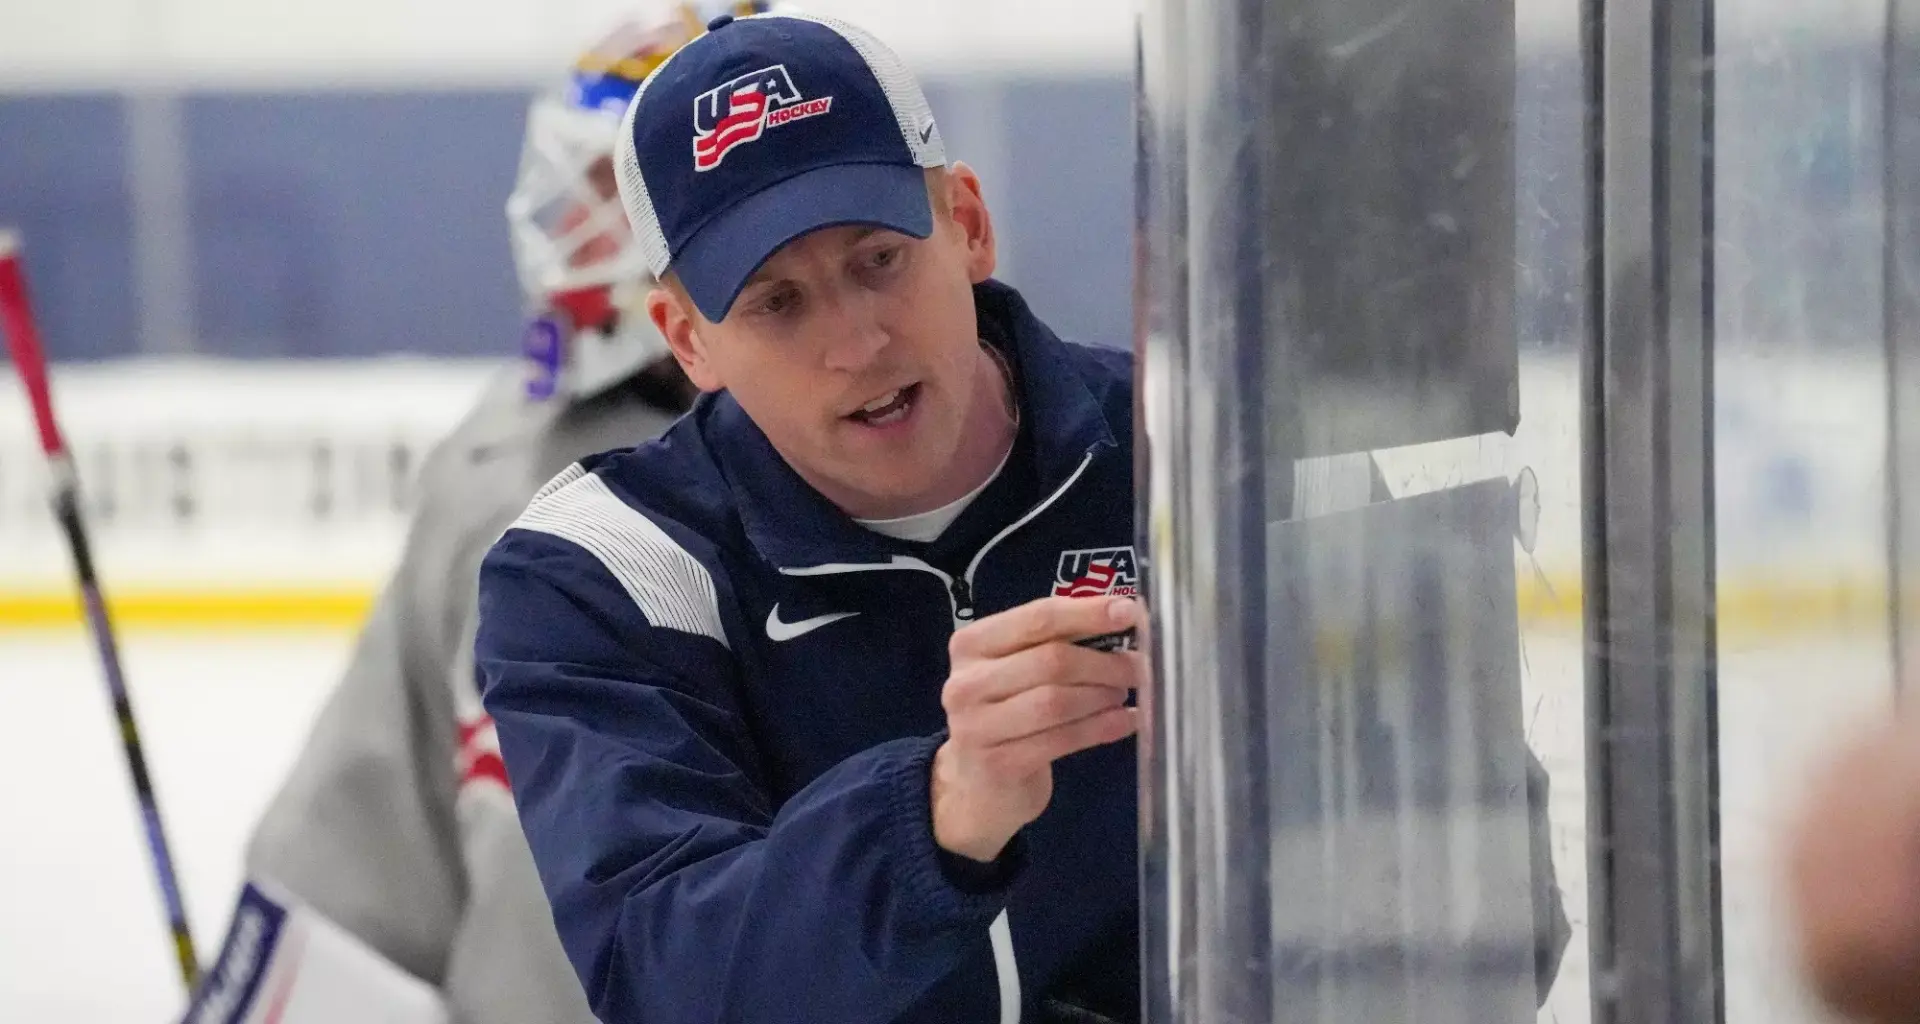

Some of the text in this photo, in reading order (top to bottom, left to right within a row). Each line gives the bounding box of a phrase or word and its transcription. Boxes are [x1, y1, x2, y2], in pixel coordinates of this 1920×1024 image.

[694, 64, 803, 164] USA
[767, 98, 832, 127] HOCKEY
[1056, 547, 1138, 594] USA
[1112, 586, 1137, 596] HOC
